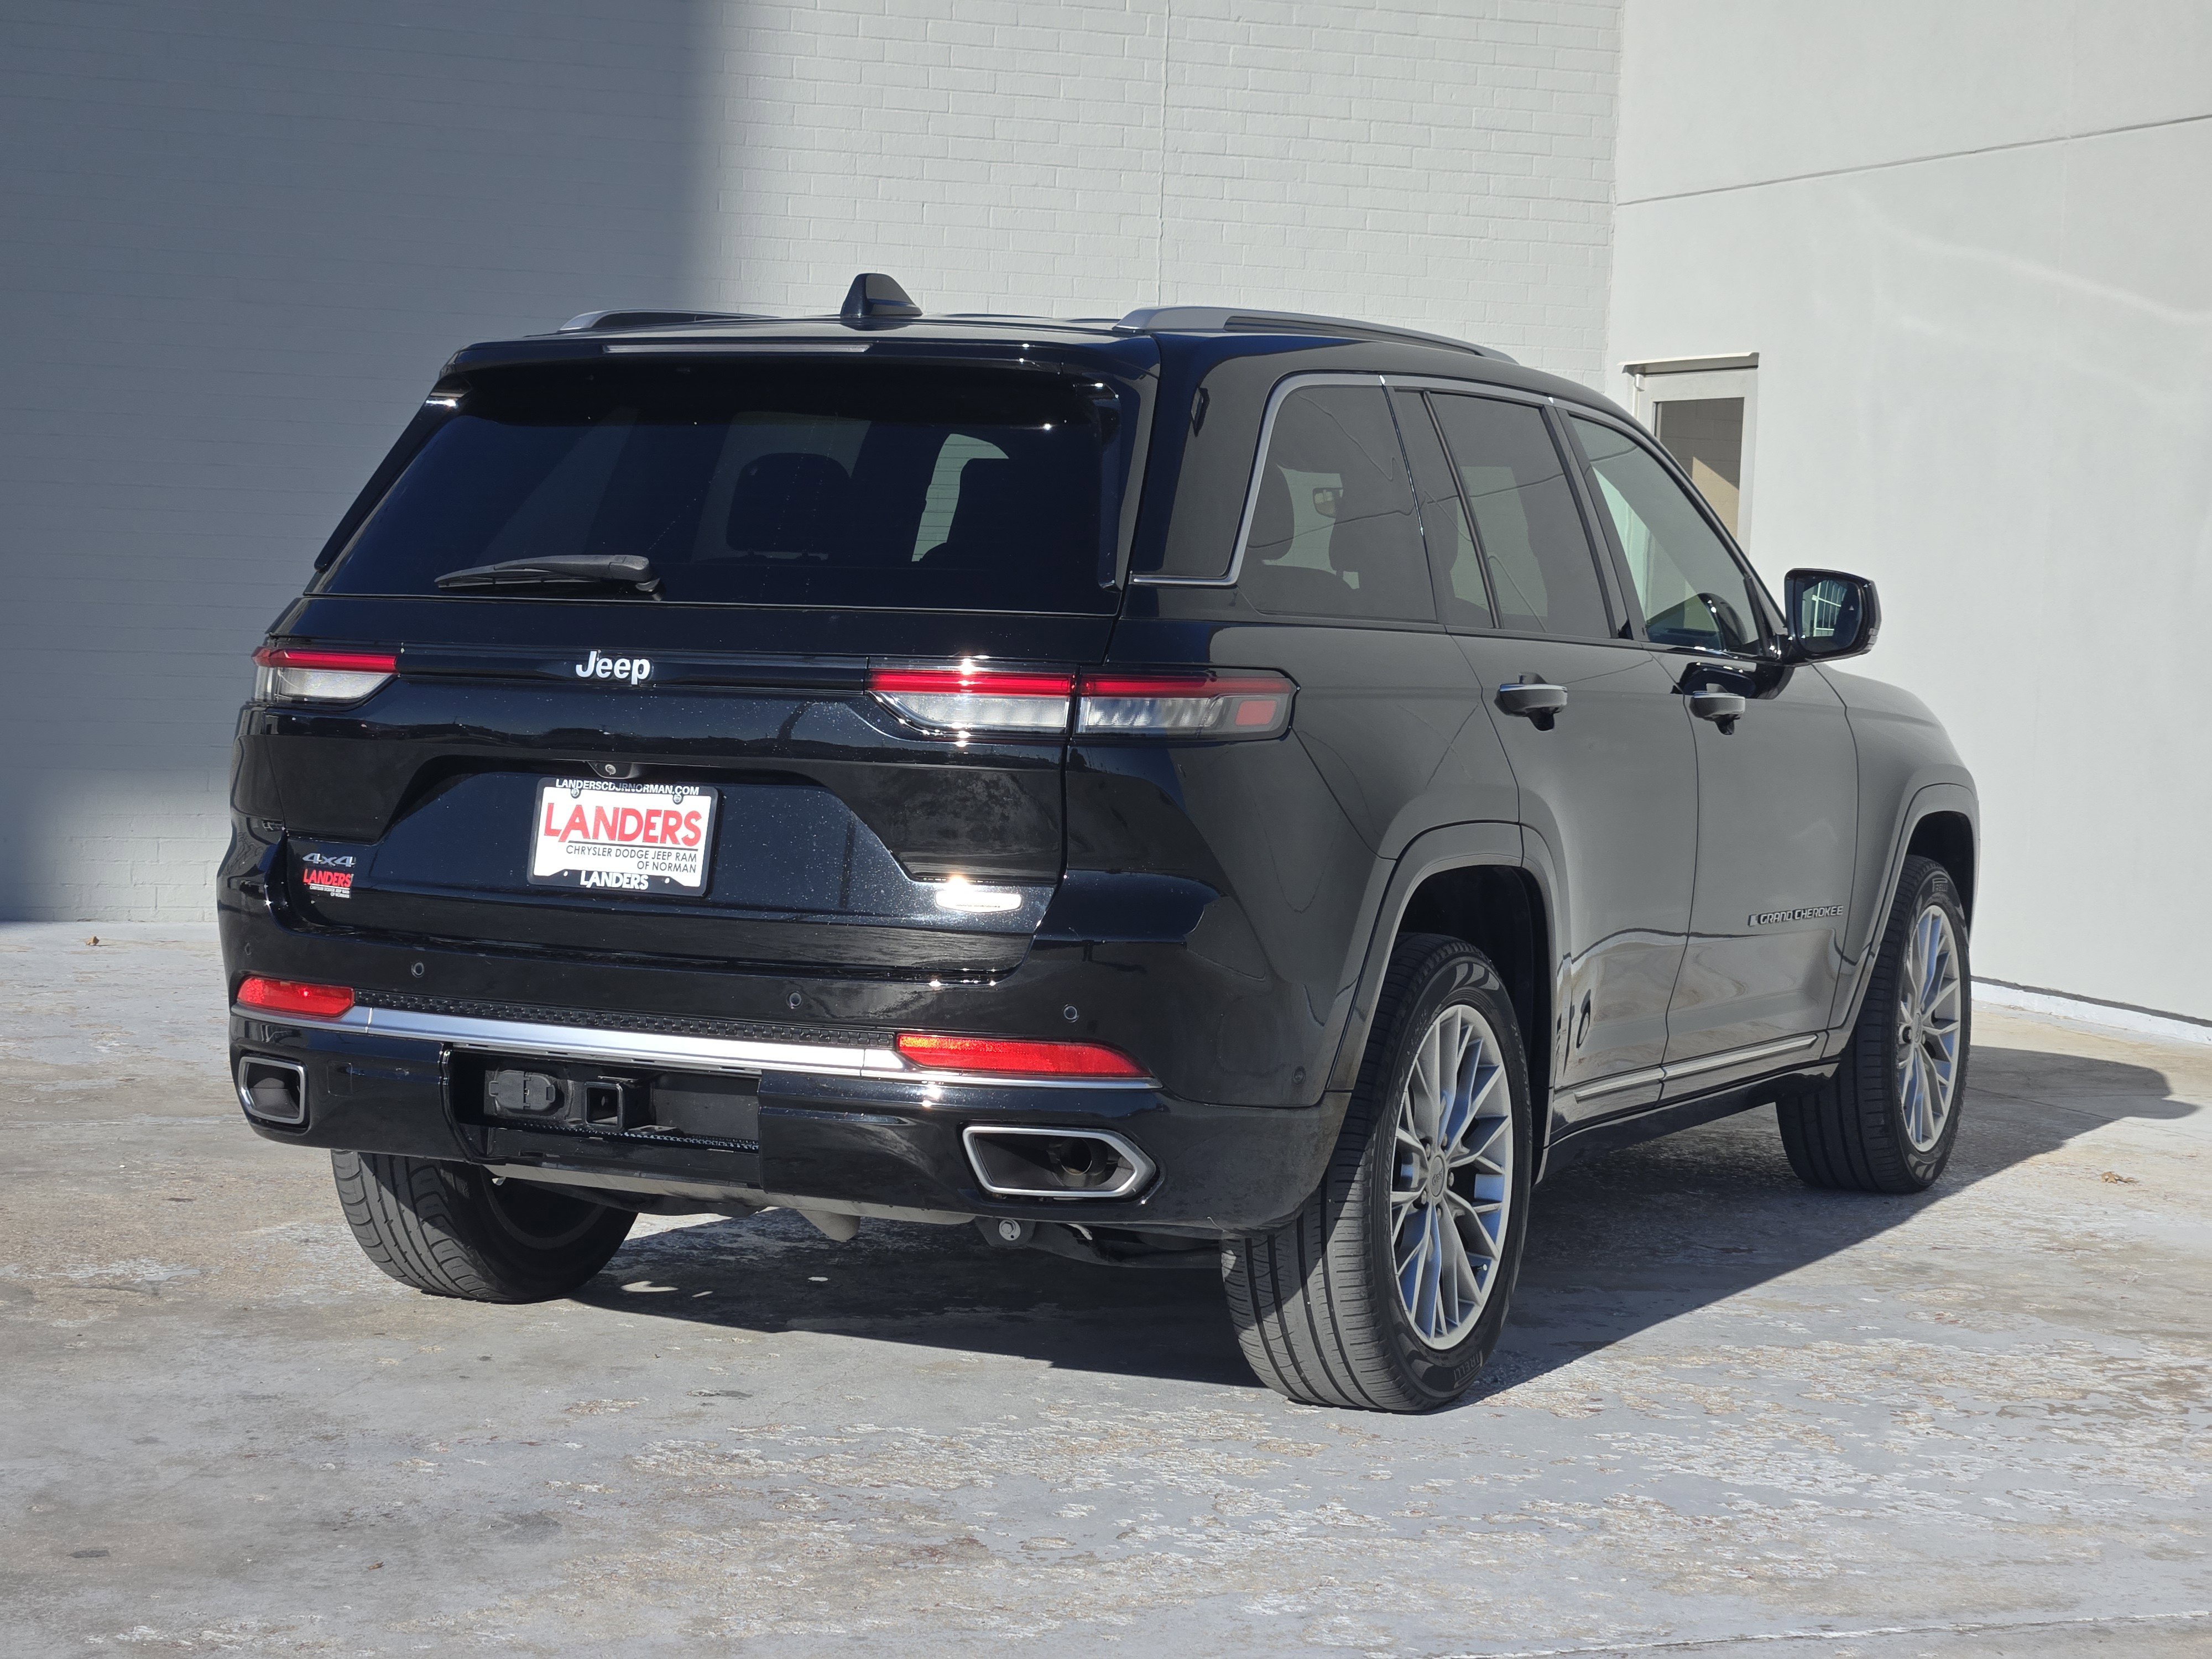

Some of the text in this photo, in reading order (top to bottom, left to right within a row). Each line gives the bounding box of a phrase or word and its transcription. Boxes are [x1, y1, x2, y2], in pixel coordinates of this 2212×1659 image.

[576, 650, 651, 685] Jeep
[555, 779, 700, 796] LANDERSCDJRNORMAN.COM
[544, 802, 702, 847] LANDERS
[302, 853, 356, 867] 4x4
[566, 844, 697, 862] CHRYSLER DODGE JEEP RAM
[637, 860, 697, 873] OF NORMAN
[303, 868, 352, 888] LANDERS
[580, 870, 649, 890] LANDERS
[1759, 905, 1844, 925] GRAND CHEROKEE
[1454, 1349, 1483, 1389] PIRELLI
